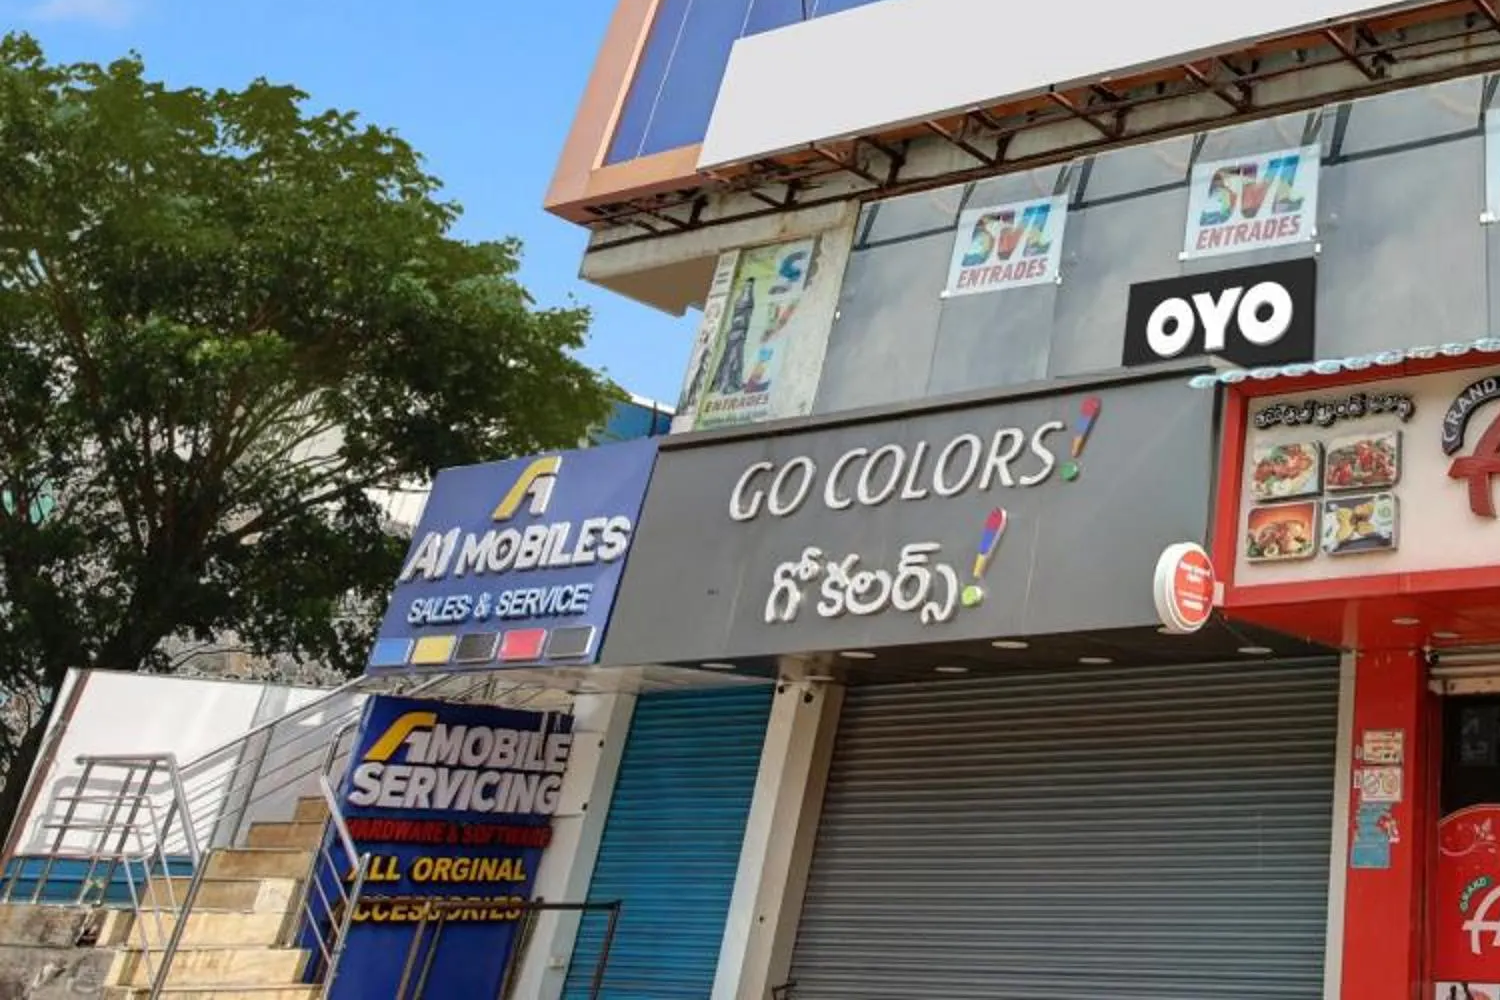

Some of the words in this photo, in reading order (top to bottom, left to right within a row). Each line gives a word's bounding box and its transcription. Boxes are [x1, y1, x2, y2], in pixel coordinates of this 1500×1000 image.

[1200, 154, 1304, 226] SVL
[961, 203, 1053, 267] SVL
[1196, 214, 1302, 250] ENTRADES
[956, 257, 1047, 289] ENTRADES
[1146, 281, 1293, 358] OYO
[729, 456, 817, 521] GO
[454, 515, 632, 577] MOBILES
[407, 593, 474, 625] SALES
[474, 591, 493, 619] &
[496, 583, 594, 616] SERVICE
[348, 761, 562, 815] SERVICING
[412, 856, 527, 881] ORGINAL
